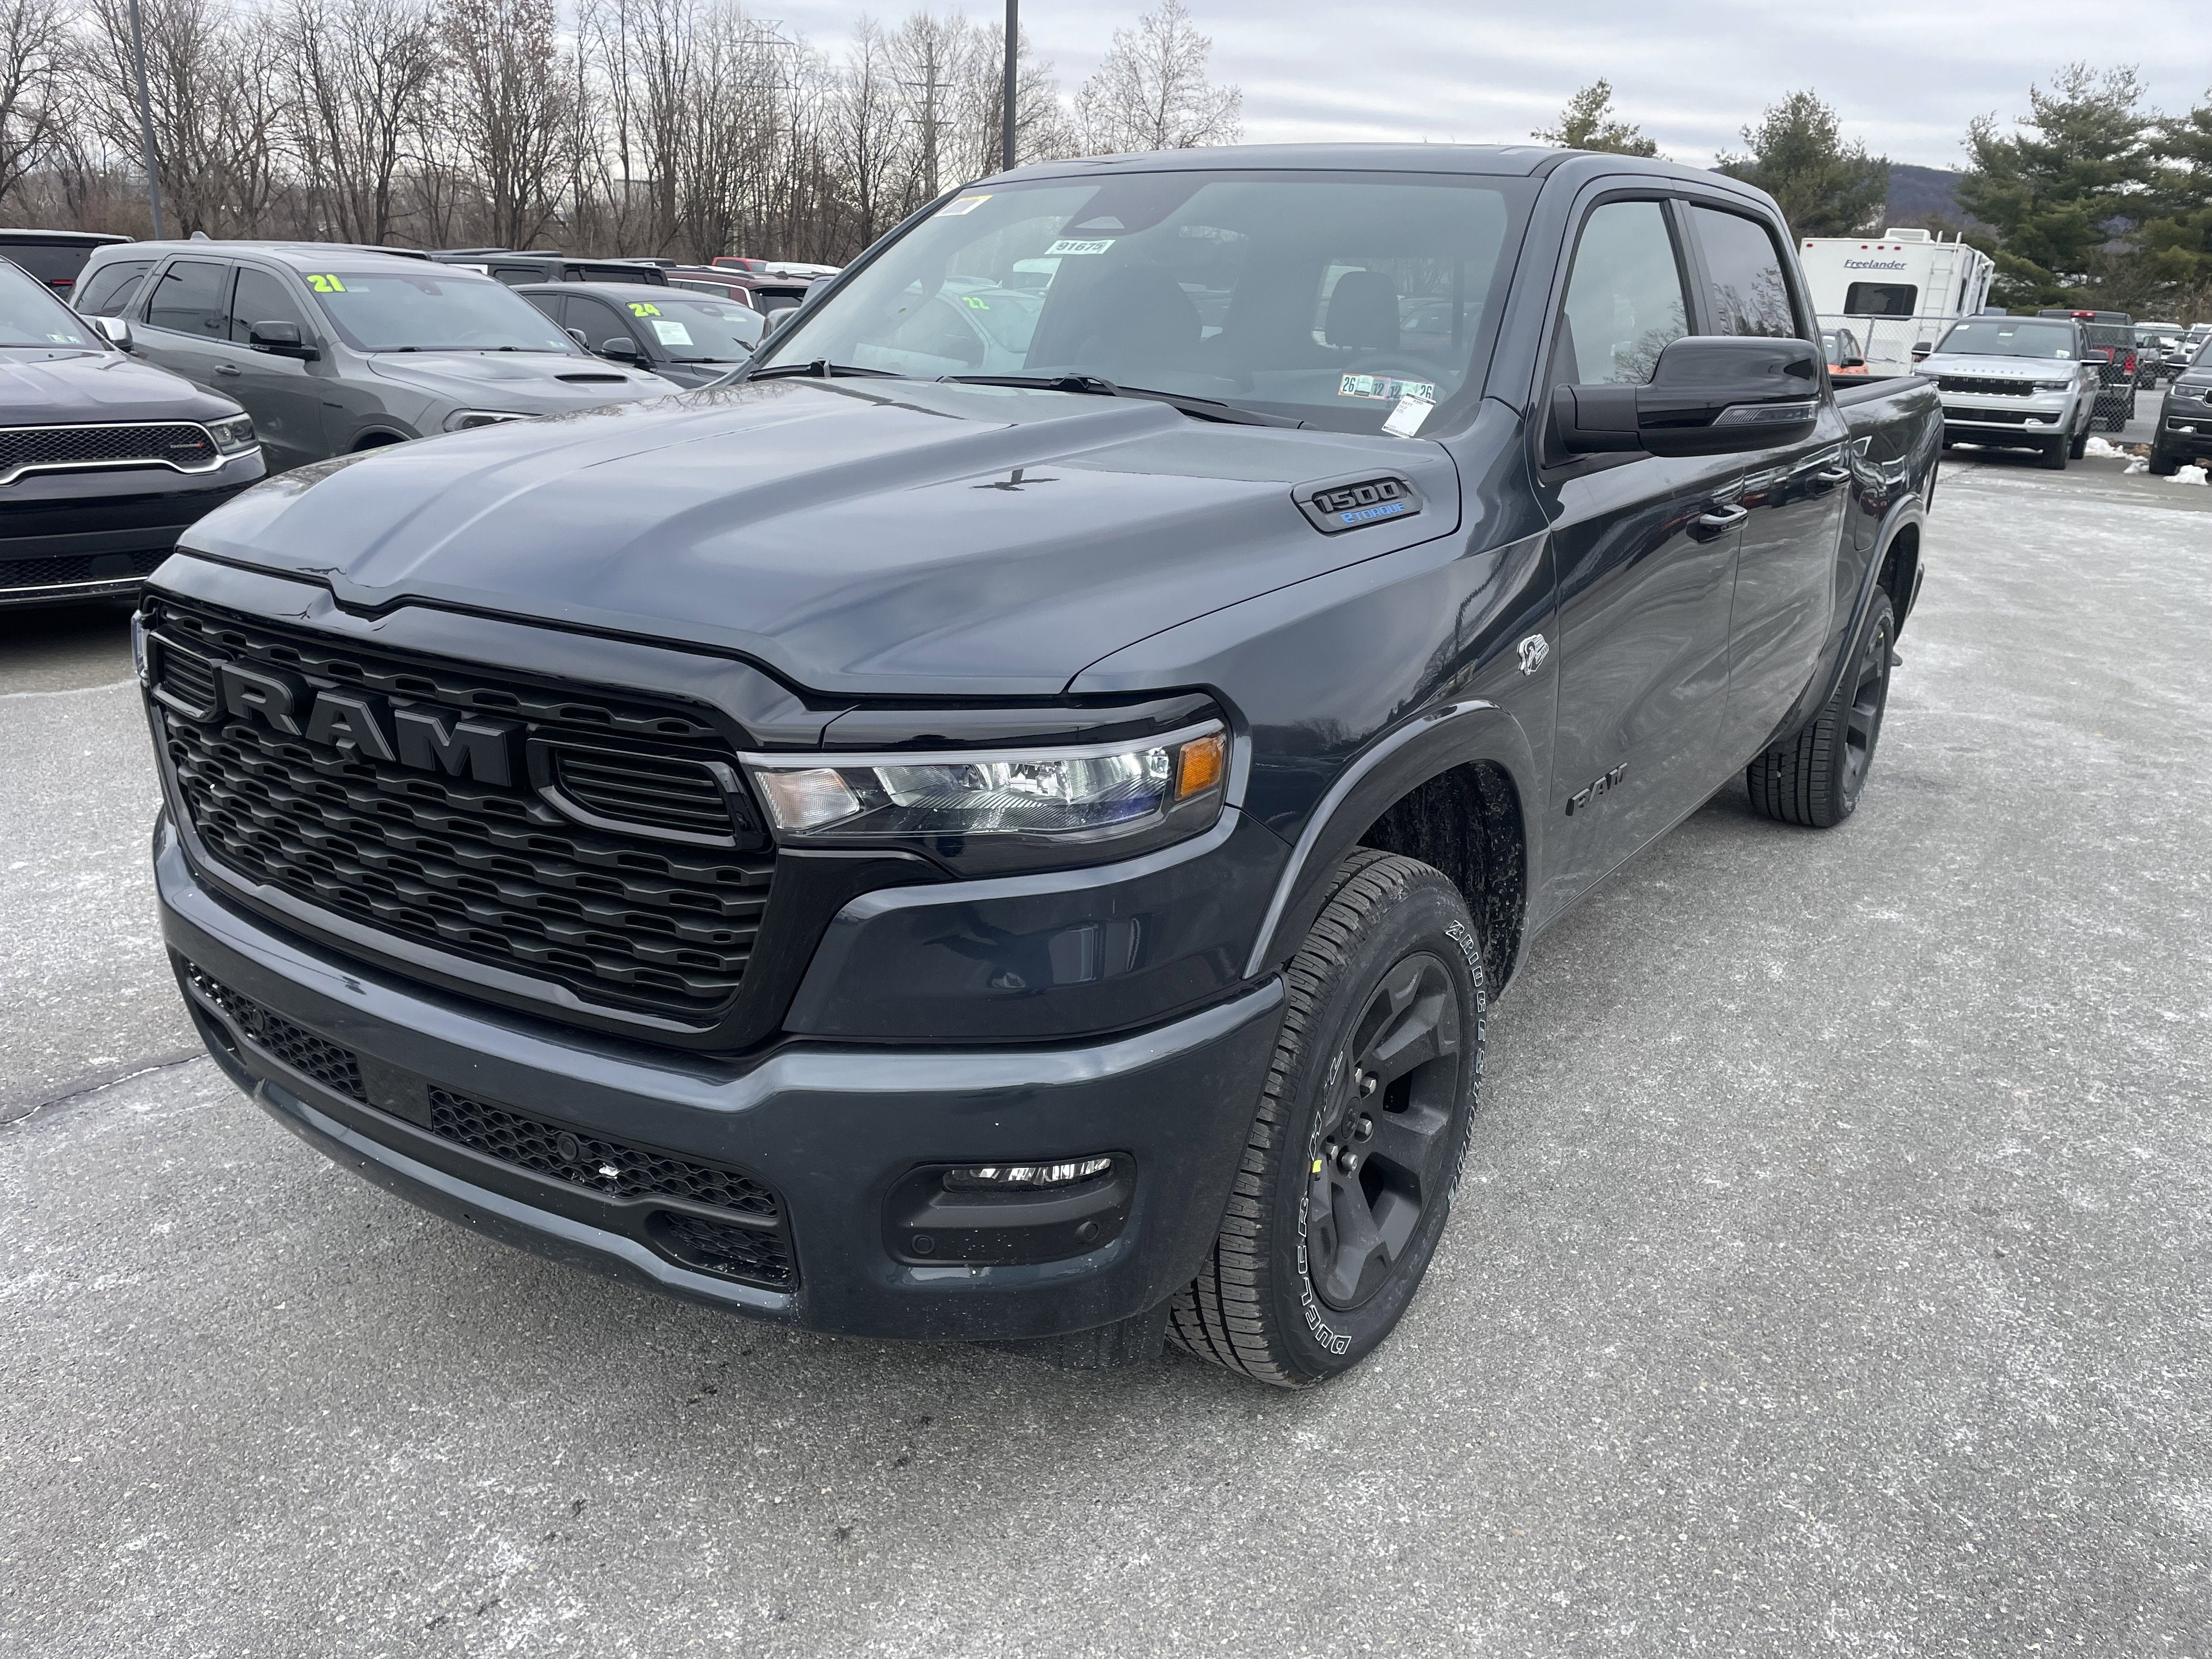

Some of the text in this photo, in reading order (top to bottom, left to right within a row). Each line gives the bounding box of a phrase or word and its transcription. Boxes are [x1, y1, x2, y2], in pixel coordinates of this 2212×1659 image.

[1056, 242, 1105, 250] 91675
[1844, 259, 1907, 270] Freelander
[307, 274, 346, 292] 21
[628, 303, 662, 317] 24
[962, 297, 990, 310] 22
[1342, 377, 1356, 392] 26
[1373, 383, 1385, 396] 12
[1390, 385, 1401, 398] 12
[1420, 385, 1432, 399] 26
[1314, 481, 1400, 512] 1500
[221, 662, 511, 787] RAM
[1565, 762, 1628, 816] RAM
